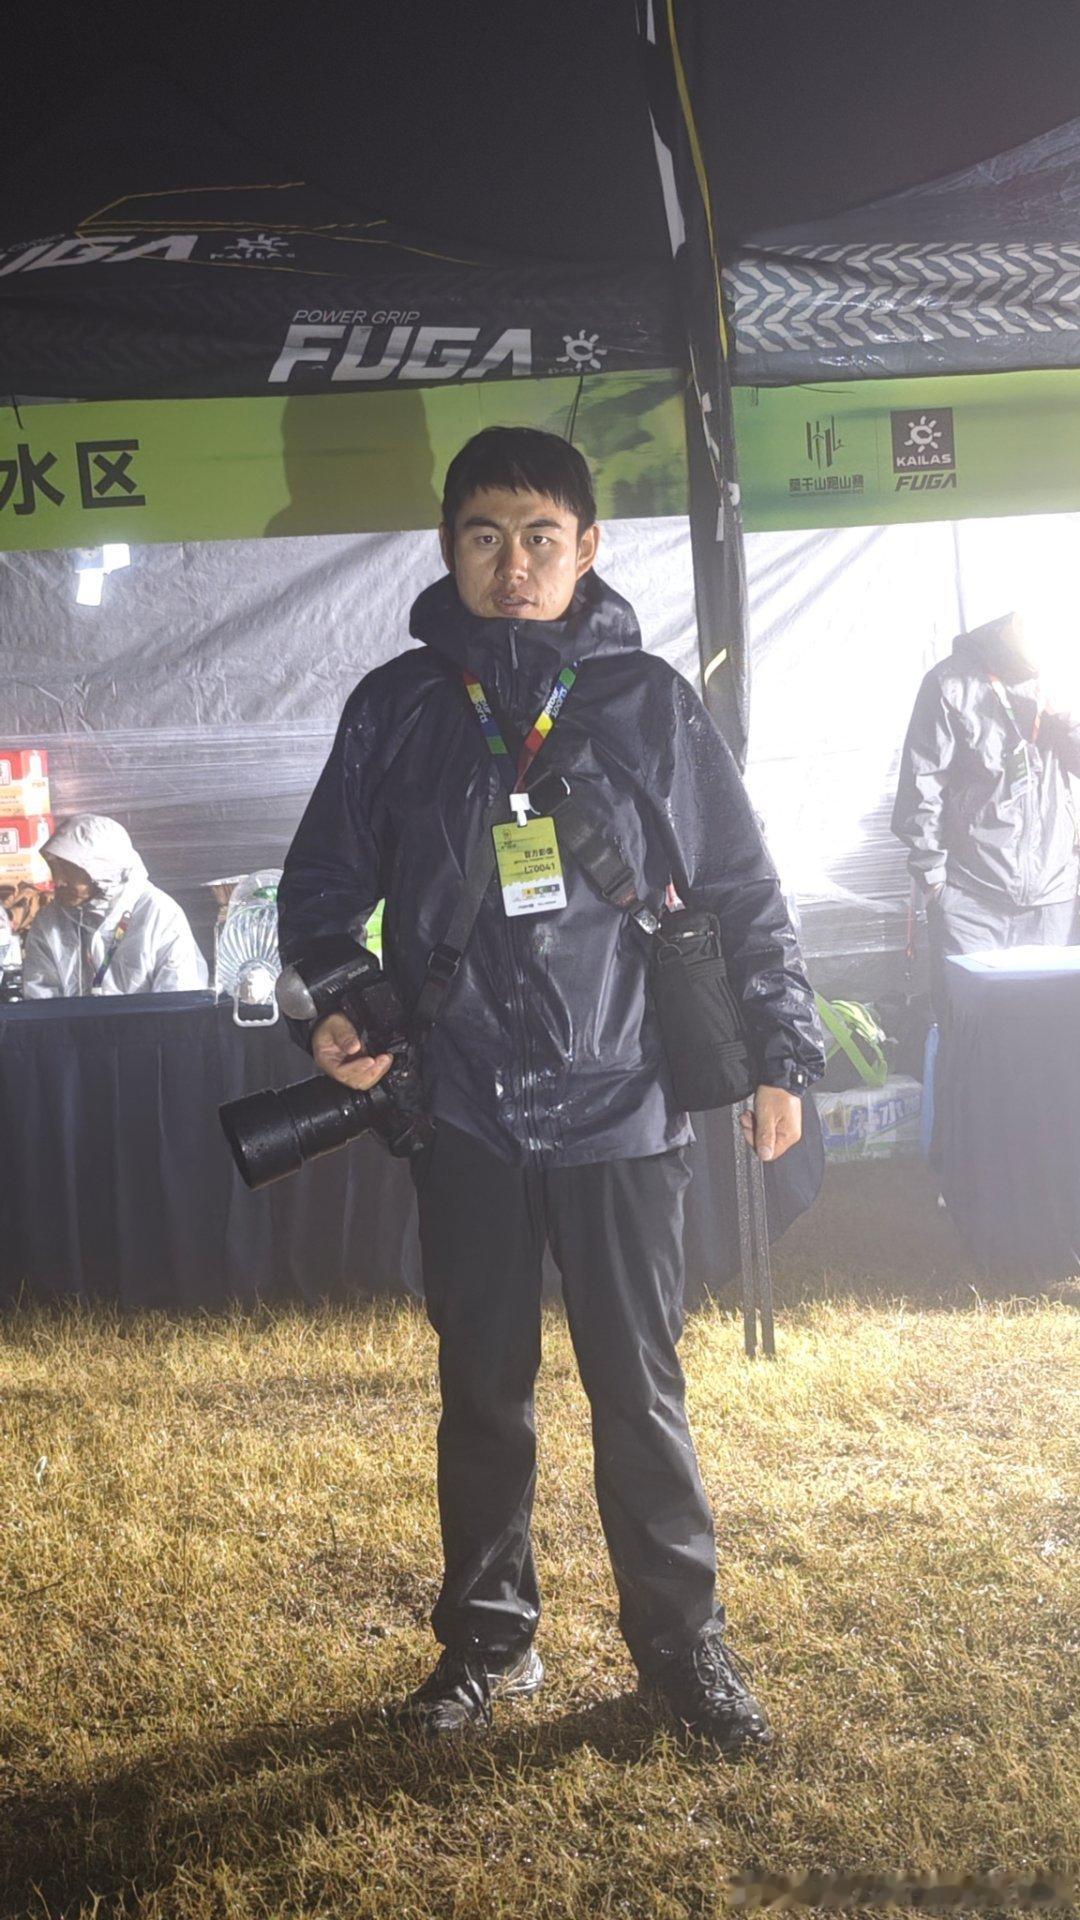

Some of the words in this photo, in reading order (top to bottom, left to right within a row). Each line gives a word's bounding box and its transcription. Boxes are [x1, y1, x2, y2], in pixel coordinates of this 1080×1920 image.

[292, 309, 367, 323] POWER
[371, 310, 421, 324] GRIP
[268, 324, 531, 383] FUGA
[896, 453, 952, 467] KAILAS
[0, 439, 146, 515] 水区
[894, 472, 957, 492] FUGA
